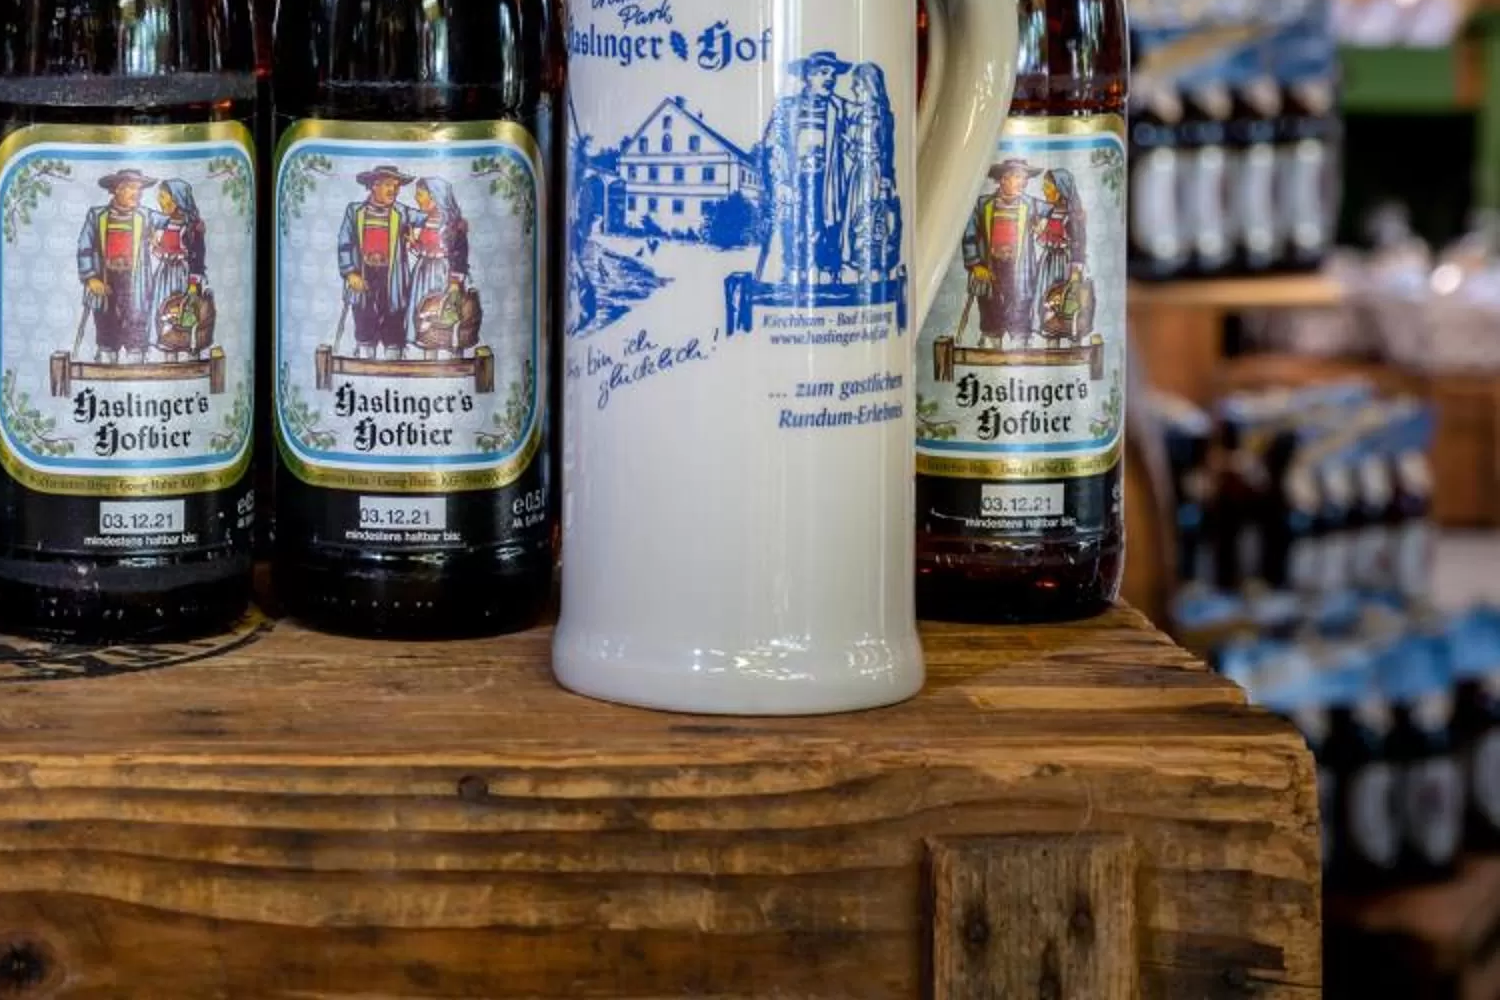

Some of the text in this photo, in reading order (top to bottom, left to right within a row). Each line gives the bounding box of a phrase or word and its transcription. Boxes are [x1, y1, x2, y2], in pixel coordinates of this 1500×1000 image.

[697, 19, 773, 72] Hof
[73, 386, 209, 423] Haslinger's
[335, 382, 473, 419] Haslinger's
[795, 382, 834, 398] zum
[956, 372, 1088, 408] Haslinger's
[94, 421, 192, 457] Hofbier
[354, 417, 453, 452] Hofbier
[977, 405, 1072, 440] Hofbier
[102, 513, 173, 529] 03.12.21
[360, 508, 431, 524] 03.12.21
[982, 496, 1052, 512] 03.12.21
